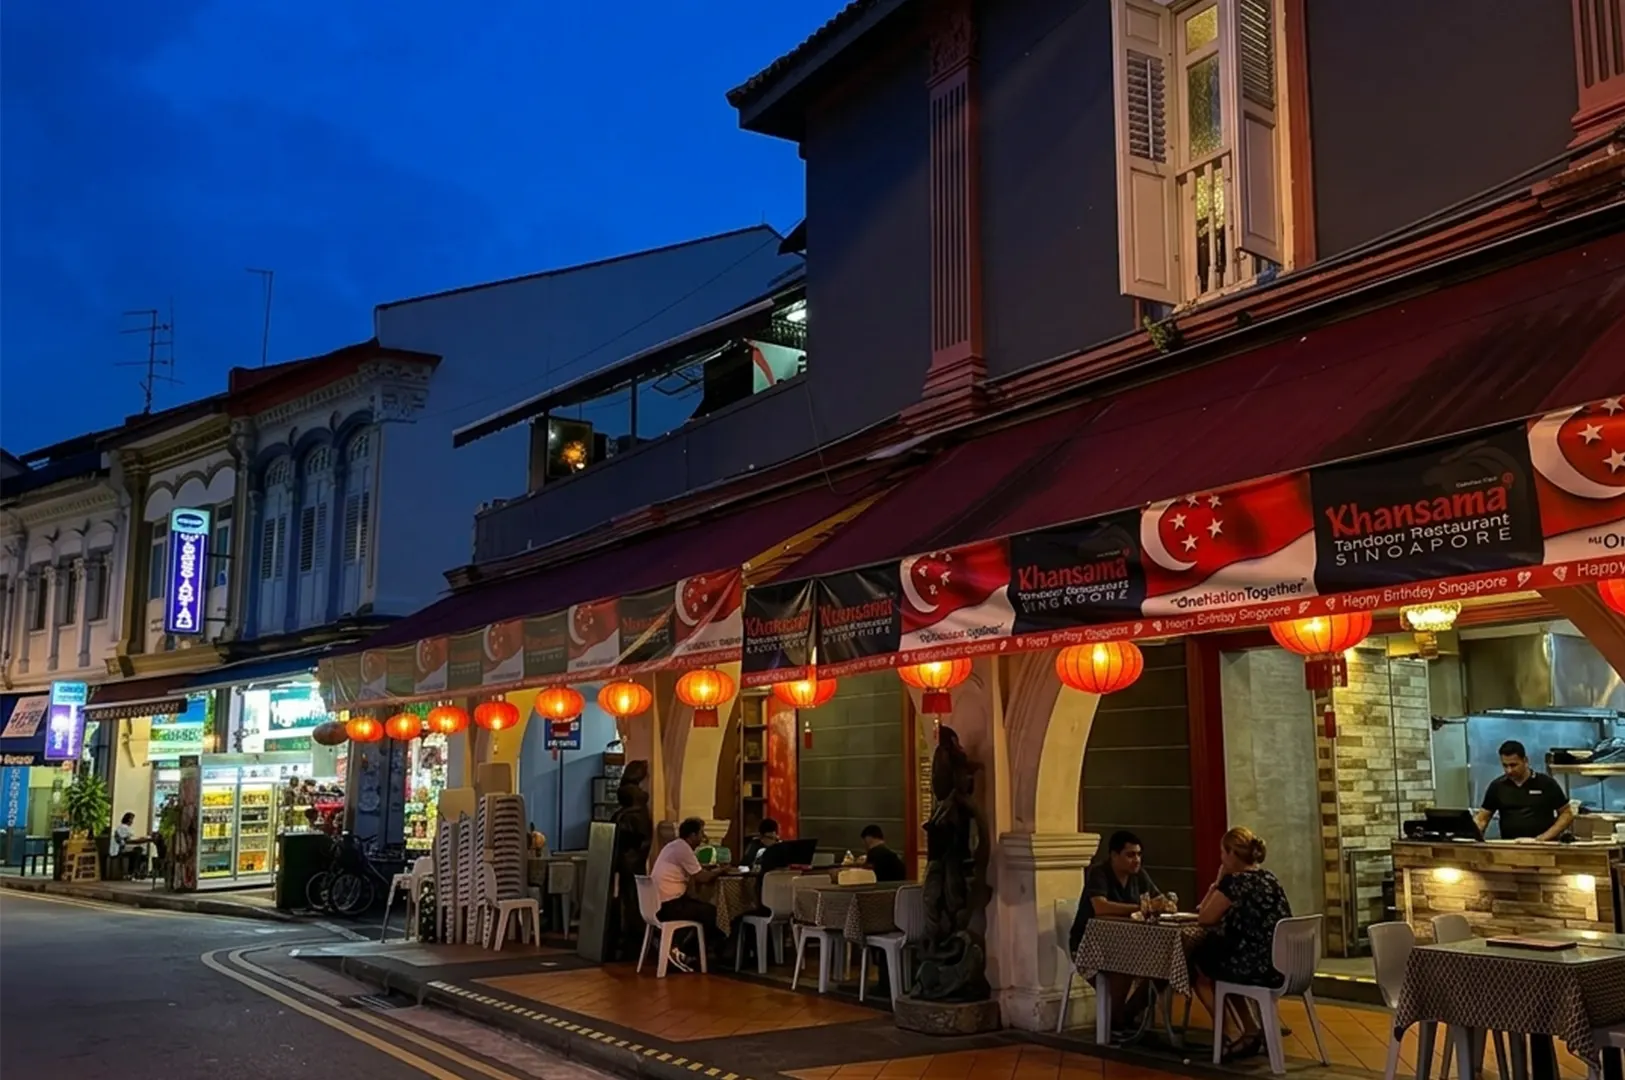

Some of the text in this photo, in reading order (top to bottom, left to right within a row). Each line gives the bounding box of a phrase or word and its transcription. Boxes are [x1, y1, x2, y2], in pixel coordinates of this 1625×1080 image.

[1325, 486, 1508, 538] Khansama
[1410, 513, 1511, 539] Restaurant
[1017, 557, 1128, 591] Khansama
